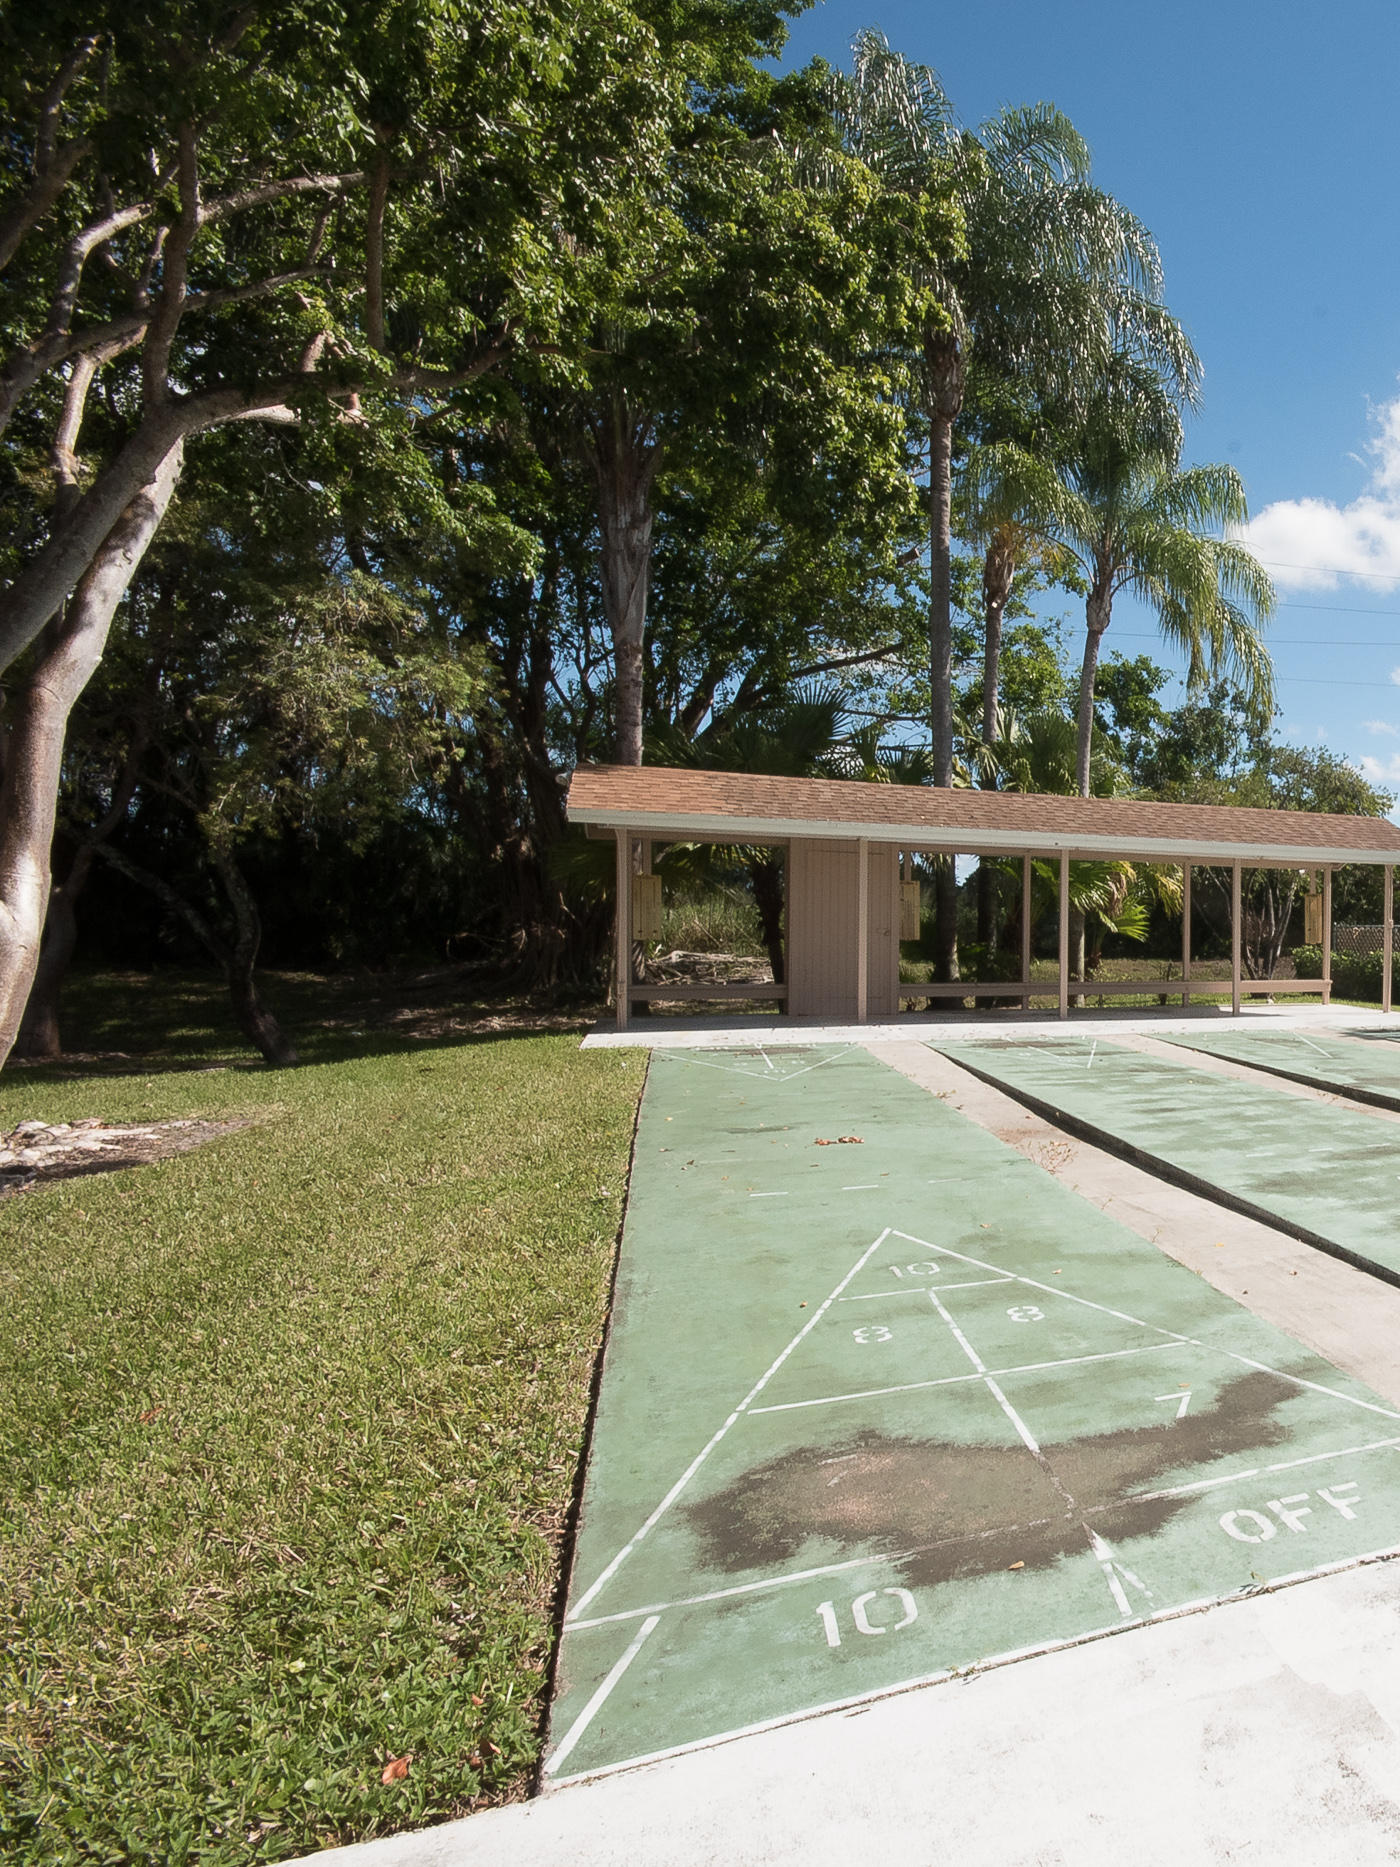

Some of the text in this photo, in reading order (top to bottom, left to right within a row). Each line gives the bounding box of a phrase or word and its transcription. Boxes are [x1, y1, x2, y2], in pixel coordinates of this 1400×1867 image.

[888, 1262, 941, 1279] 10
[1006, 1305, 1046, 1322] 8
[852, 1326, 893, 1344] 8
[1154, 1391, 1193, 1419] 7
[1219, 1481, 1362, 1544] OFF
[815, 1587, 919, 1648] 10
